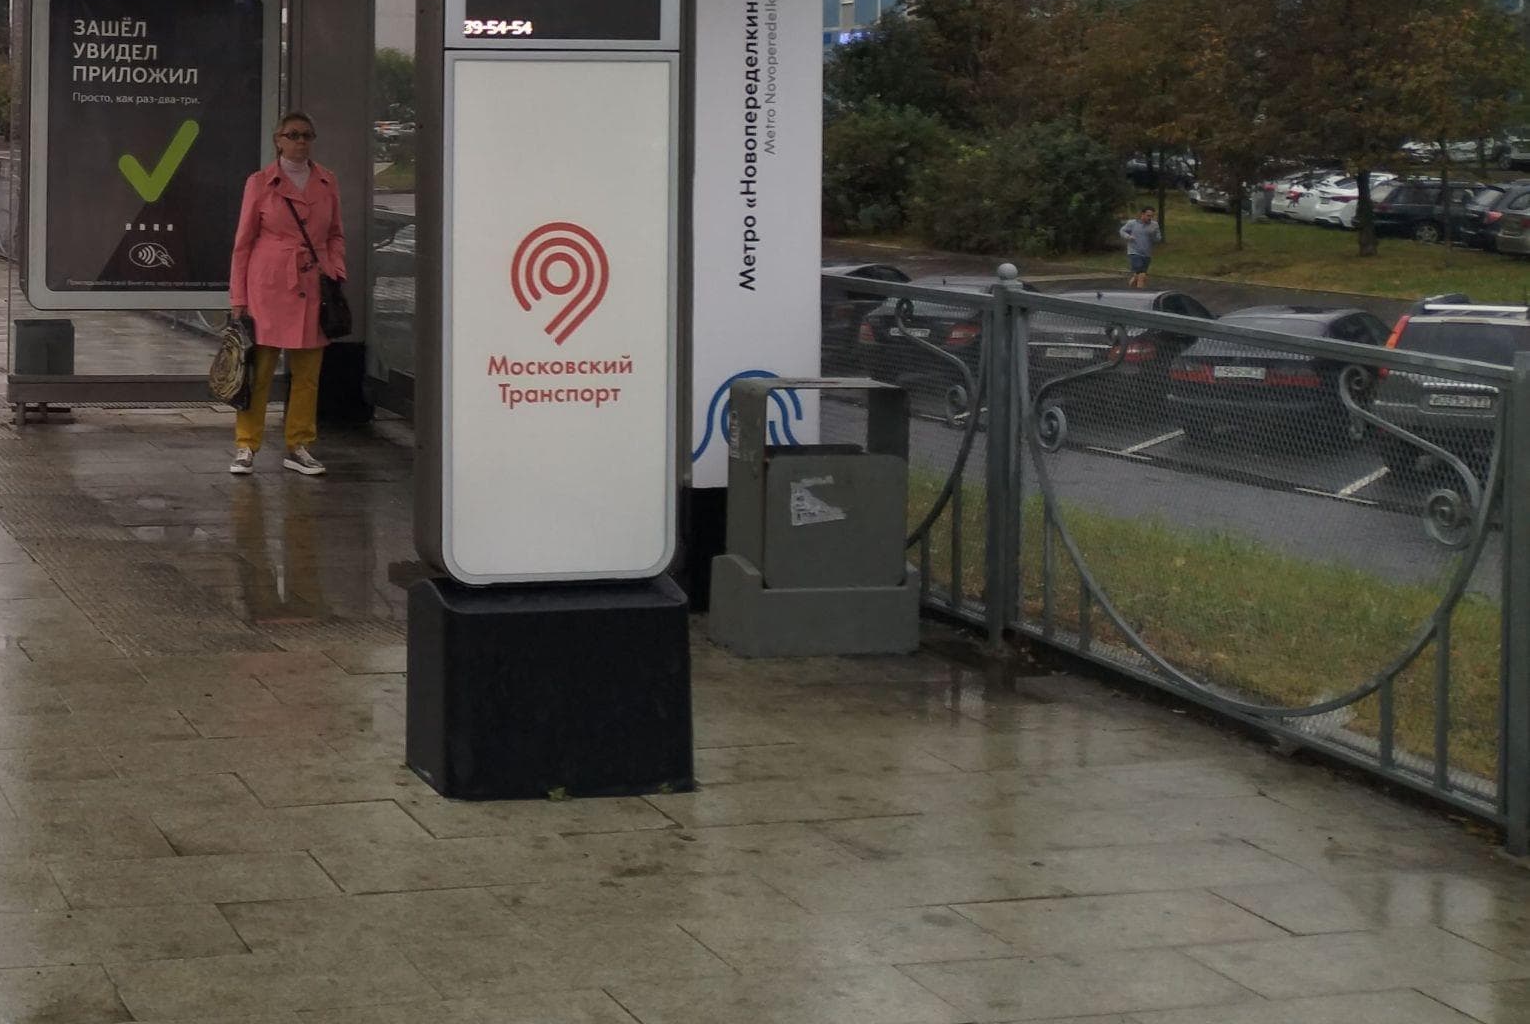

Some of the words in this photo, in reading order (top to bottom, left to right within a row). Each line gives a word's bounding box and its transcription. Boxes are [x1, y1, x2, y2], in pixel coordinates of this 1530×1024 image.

[74, 17, 147, 37] ЗАШЁЛ
[73, 43, 158, 63] УВИДЕЛ
[73, 65, 199, 85] ПРИЛОЖИЛ
[117, 94, 134, 103] как
[764, 109, 776, 155] Metro
[738, 215, 760, 291] Метро
[487, 355, 633, 376] Московский
[498, 383, 622, 409] Транспорт
